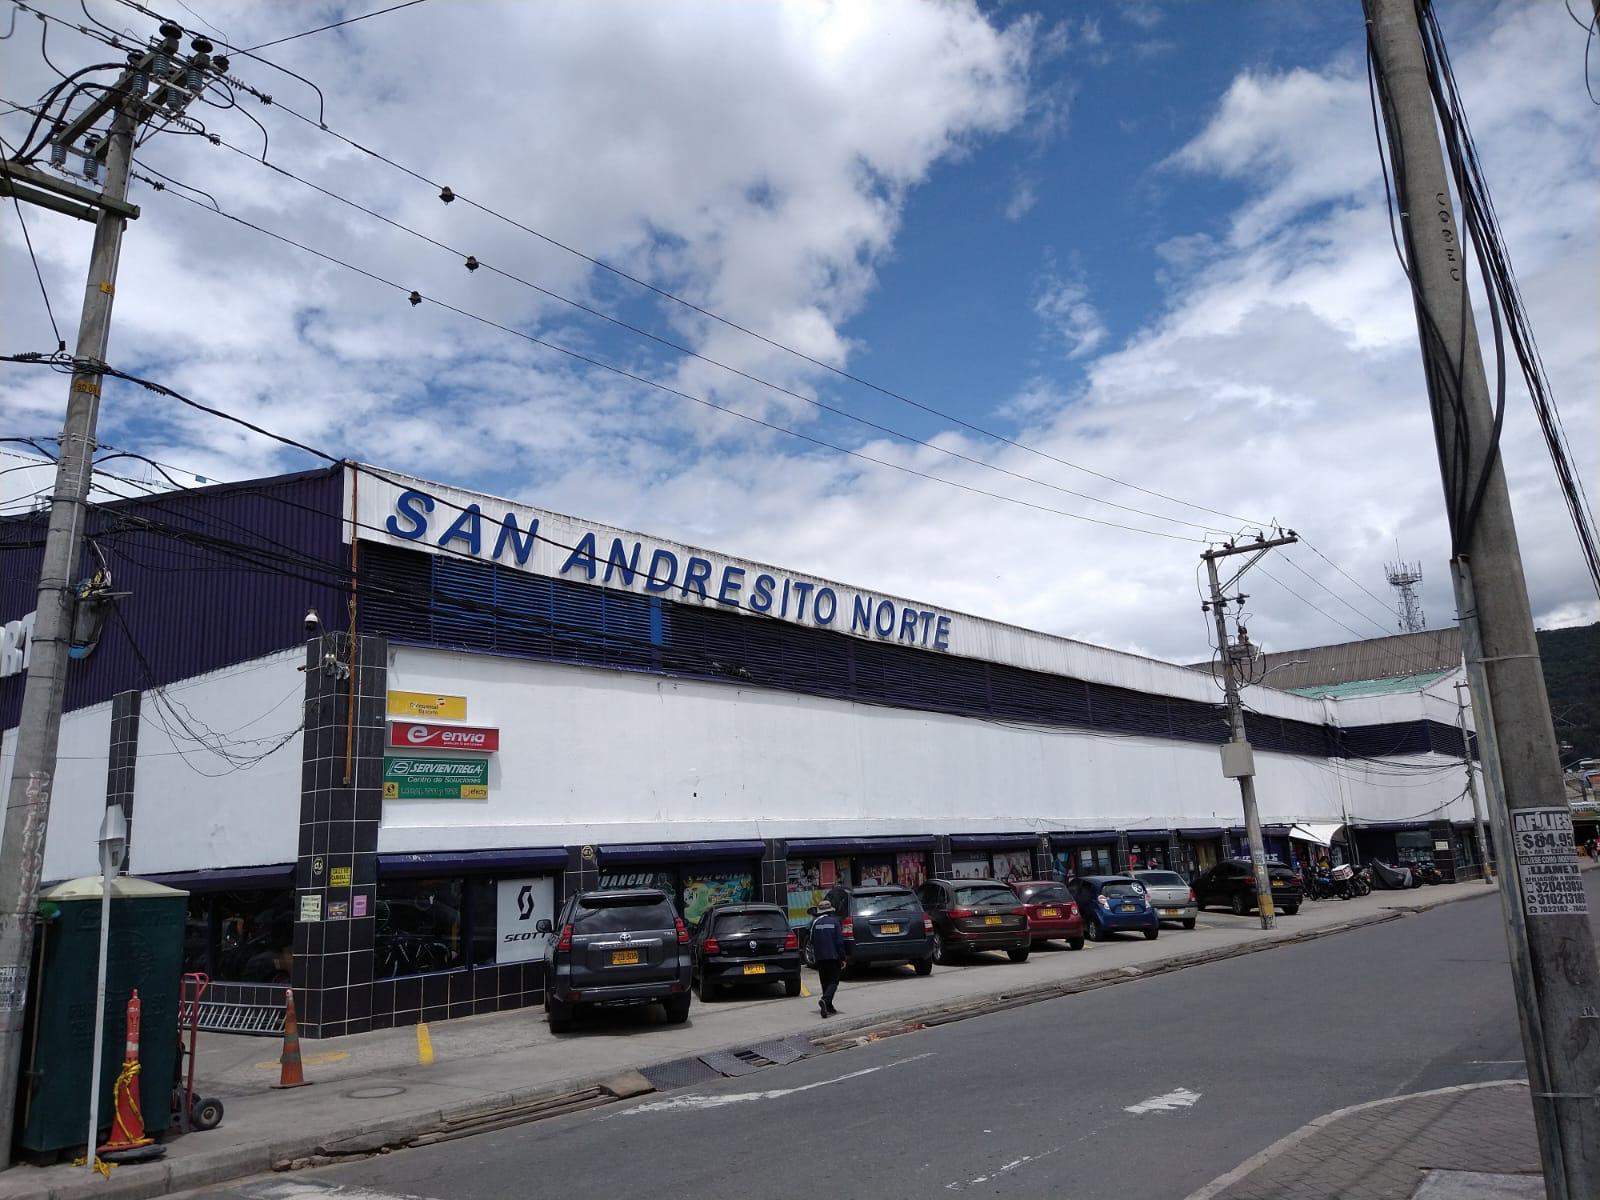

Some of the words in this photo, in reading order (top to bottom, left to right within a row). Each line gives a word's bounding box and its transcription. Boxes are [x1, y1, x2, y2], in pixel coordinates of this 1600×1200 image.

[386, 489, 540, 565] SAN
[559, 532, 837, 625] ANDRESITO
[852, 594, 952, 649] NORTE
[409, 763, 482, 774] SERVIENTREGA
[503, 932, 547, 943] SCOTT
